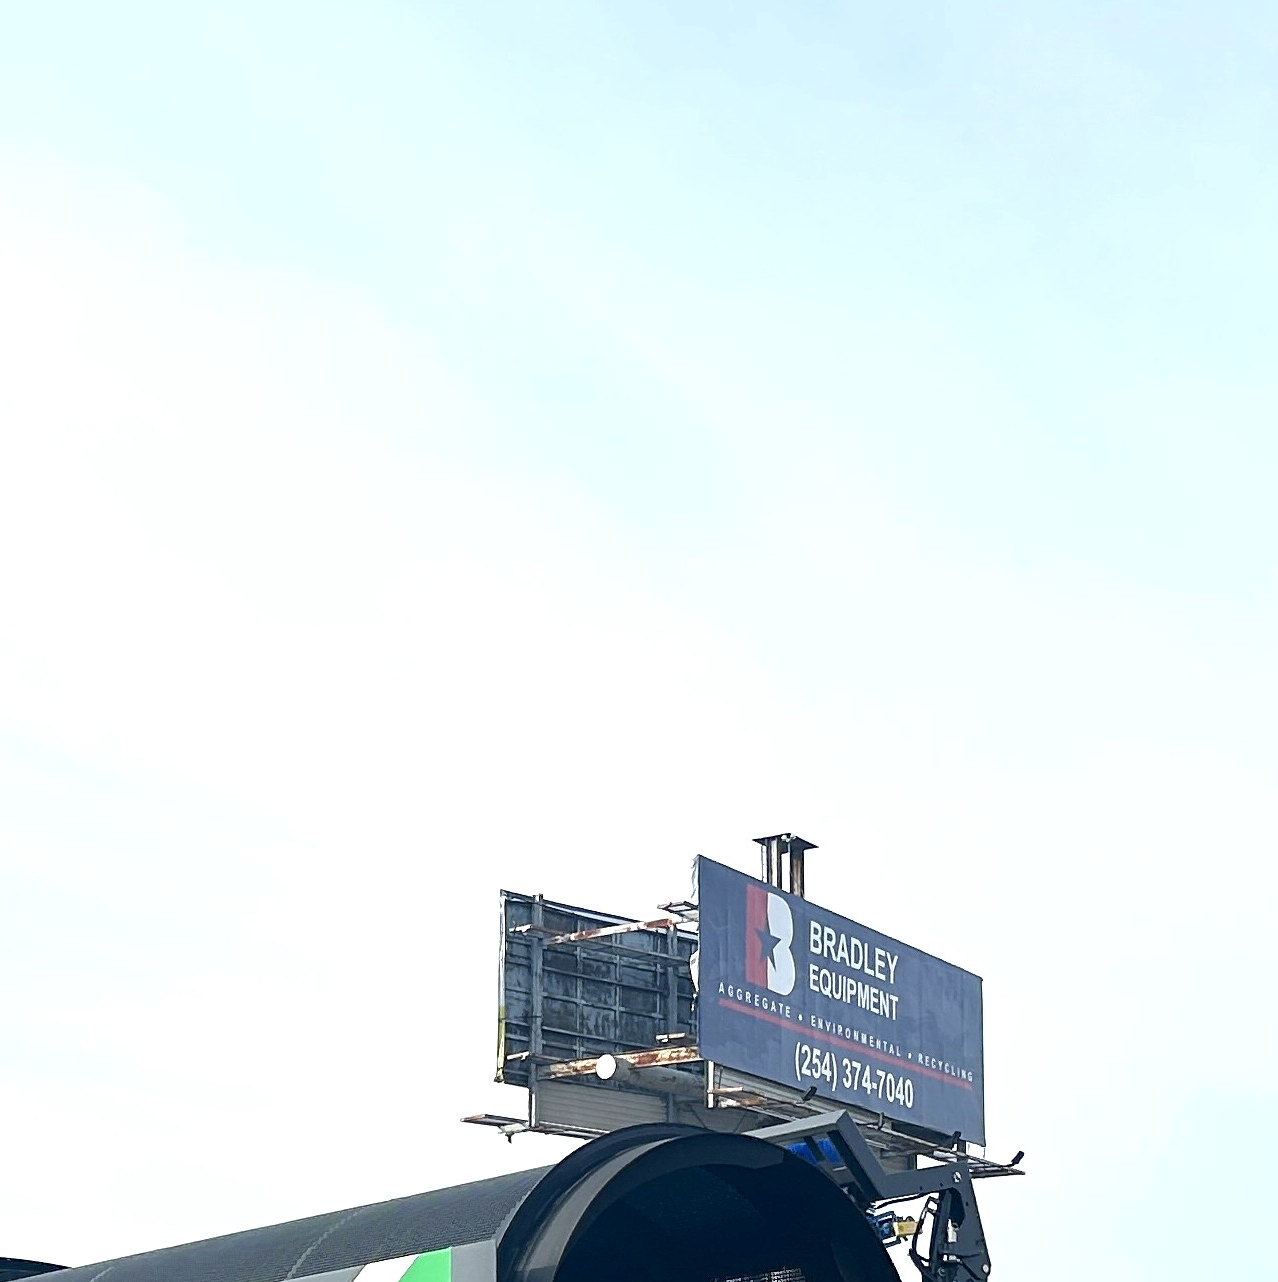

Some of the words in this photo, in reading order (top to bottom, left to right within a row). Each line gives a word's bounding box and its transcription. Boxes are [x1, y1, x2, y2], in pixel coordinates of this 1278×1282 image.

[810, 920, 899, 984] BRADLEY
[809, 963, 899, 1021] EQUIPMENT
[718, 982, 792, 1018] AGGREGATE
[810, 1015, 902, 1057] ENVIRONMENTAL
[918, 1053, 973, 1082] RECYCLING
[795, 1042, 838, 1092] (254)
[842, 1058, 914, 1109] 374-7040
